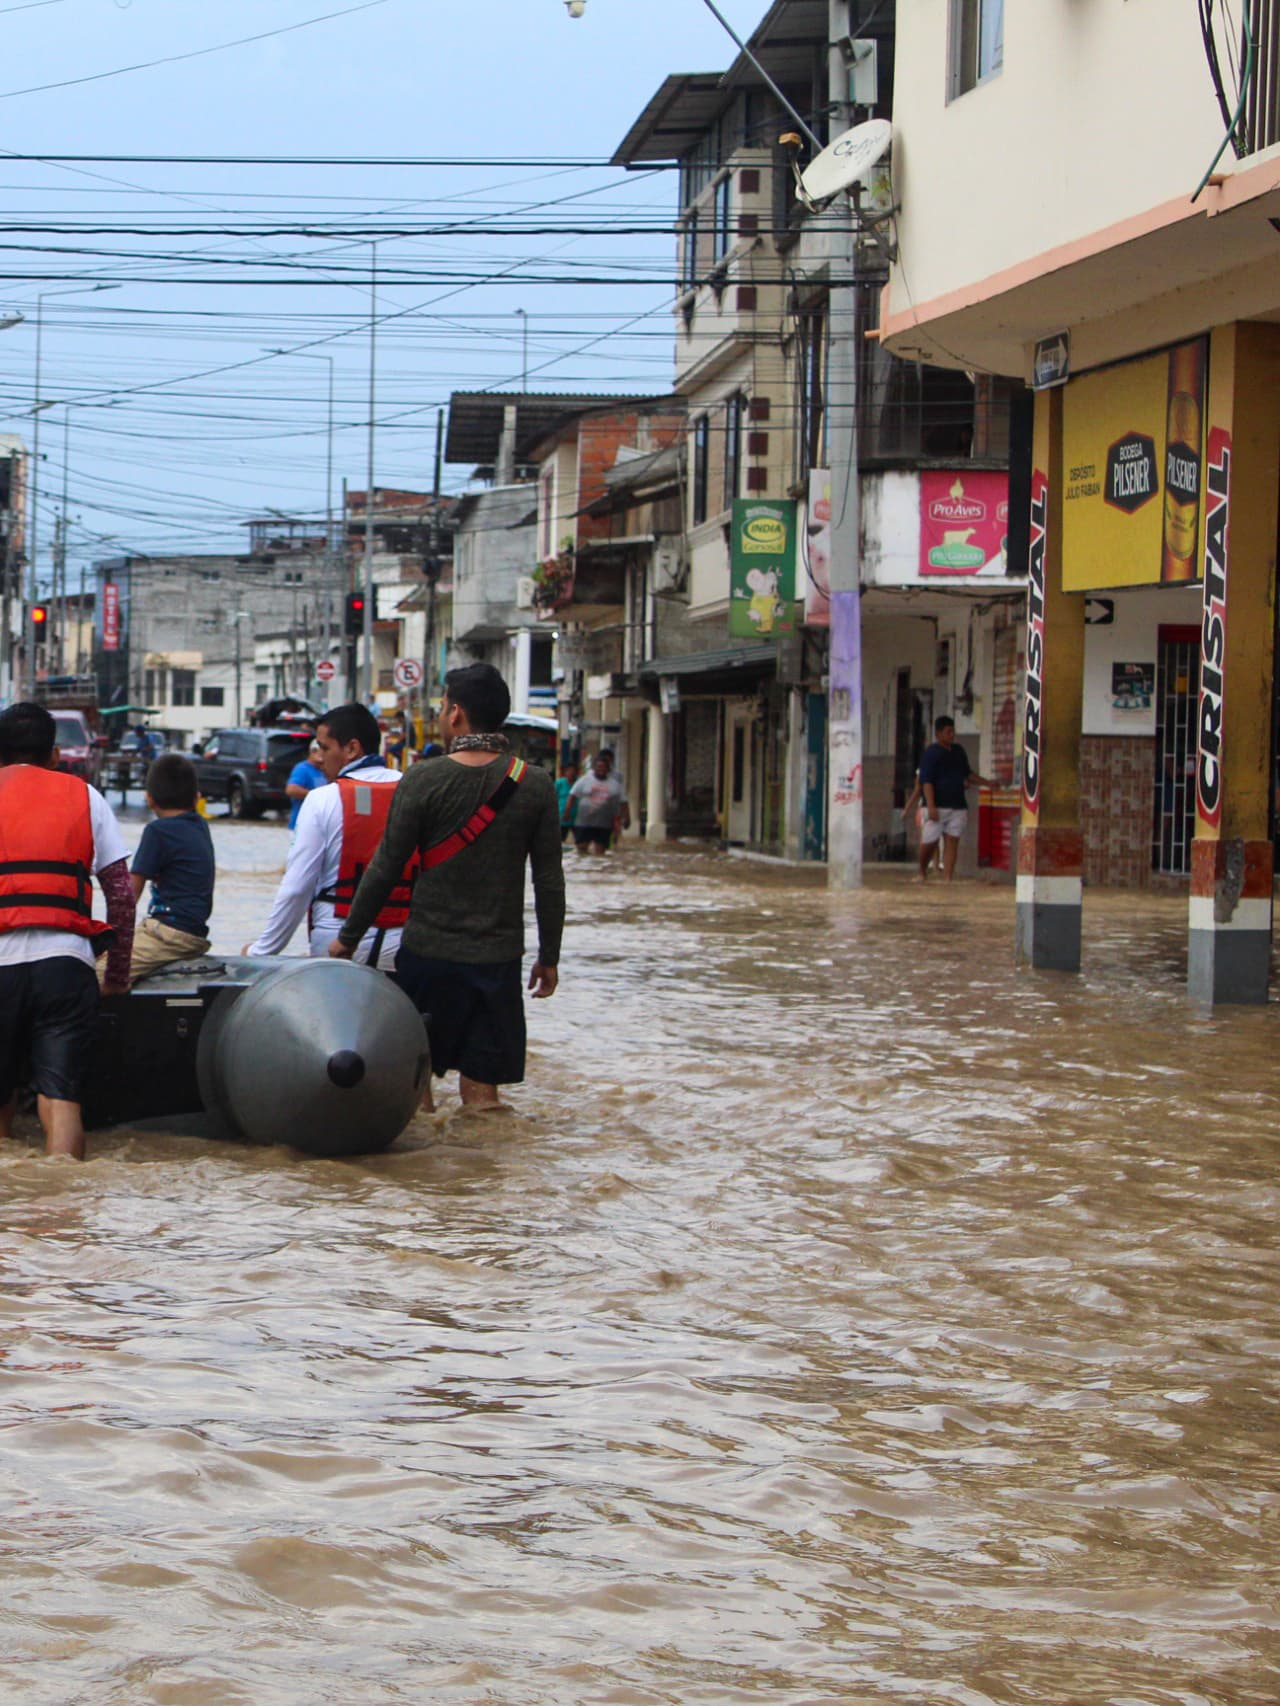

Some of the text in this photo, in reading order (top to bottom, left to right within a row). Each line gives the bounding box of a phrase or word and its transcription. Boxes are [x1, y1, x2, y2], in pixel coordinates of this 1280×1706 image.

[1120, 443, 1143, 461] BODEGA
[1113, 457, 1150, 498] PILSENER
[1167, 452, 1197, 494] PILSENER
[751, 523, 781, 533] INDIA
[1024, 486, 1047, 801] CRISTAL
[1198, 447, 1230, 814] CRISTAL
